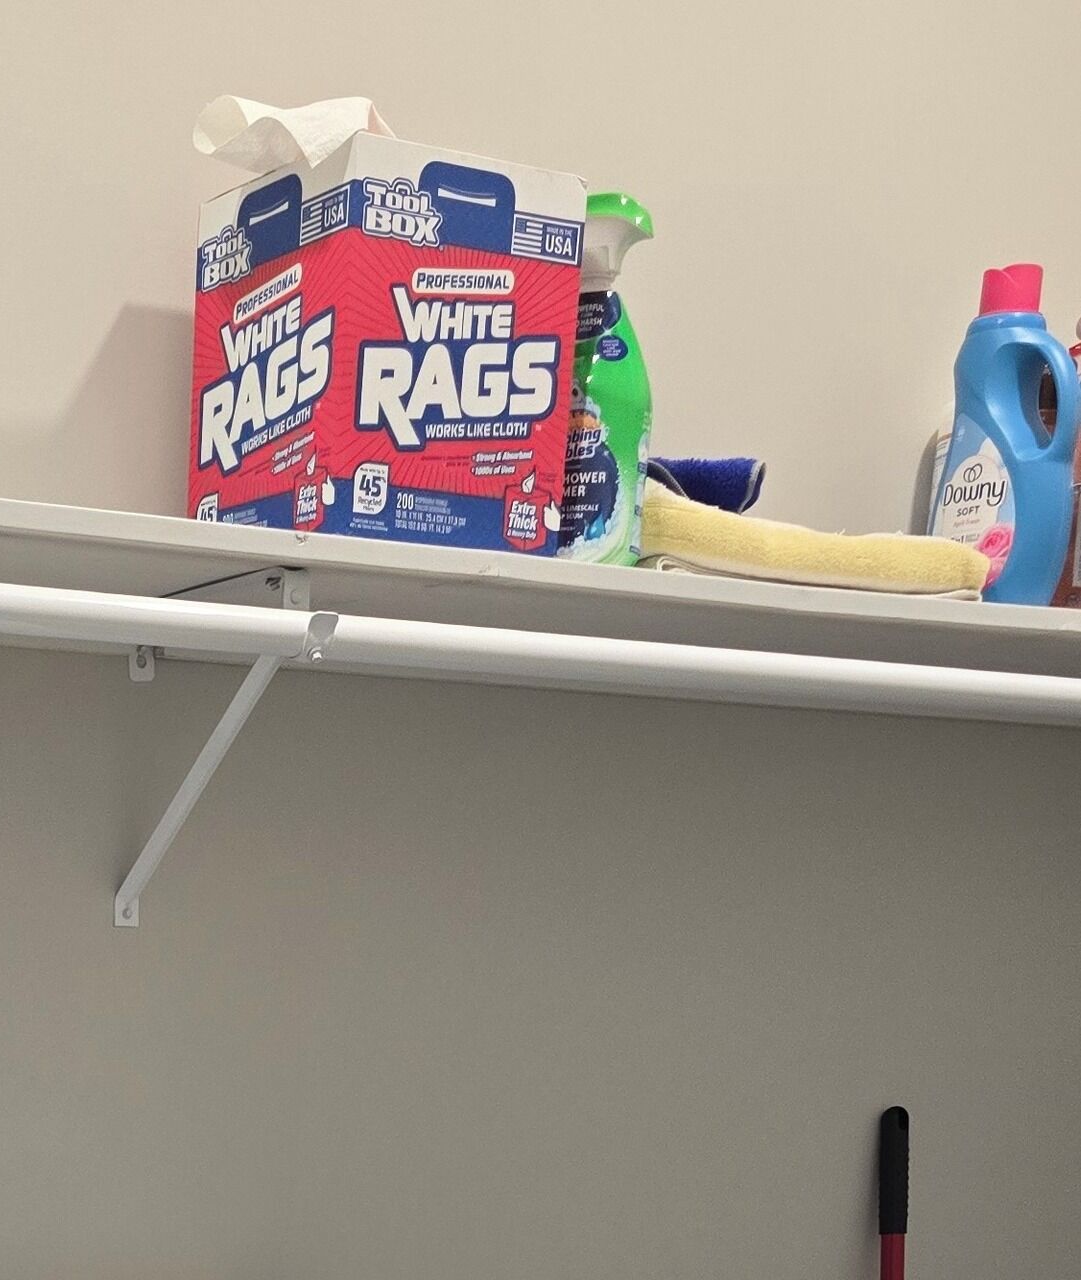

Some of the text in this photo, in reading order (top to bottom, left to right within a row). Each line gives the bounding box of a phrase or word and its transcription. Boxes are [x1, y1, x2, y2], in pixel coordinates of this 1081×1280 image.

[366, 183, 434, 216] TOOL
[324, 202, 344, 227] USA
[365, 206, 442, 244] BOX
[204, 231, 248, 262] TOOL
[545, 234, 572, 256] USA
[203, 246, 250, 288] BOX
[416, 272, 509, 289] PROFESSIONAL
[392, 287, 512, 342] WHITE
[200, 312, 332, 471] RAGS
[359, 341, 556, 445] RAGS
[241, 405, 311, 455] WORKS LIKE CLOTH
[425, 421, 528, 438] WORKS LIKE CLOTH
[397, 492, 414, 510] 200
[512, 500, 536, 514] Extra
[944, 481, 1005, 507] Downy
[508, 514, 538, 531] Thick
[957, 505, 980, 517] SOFT
